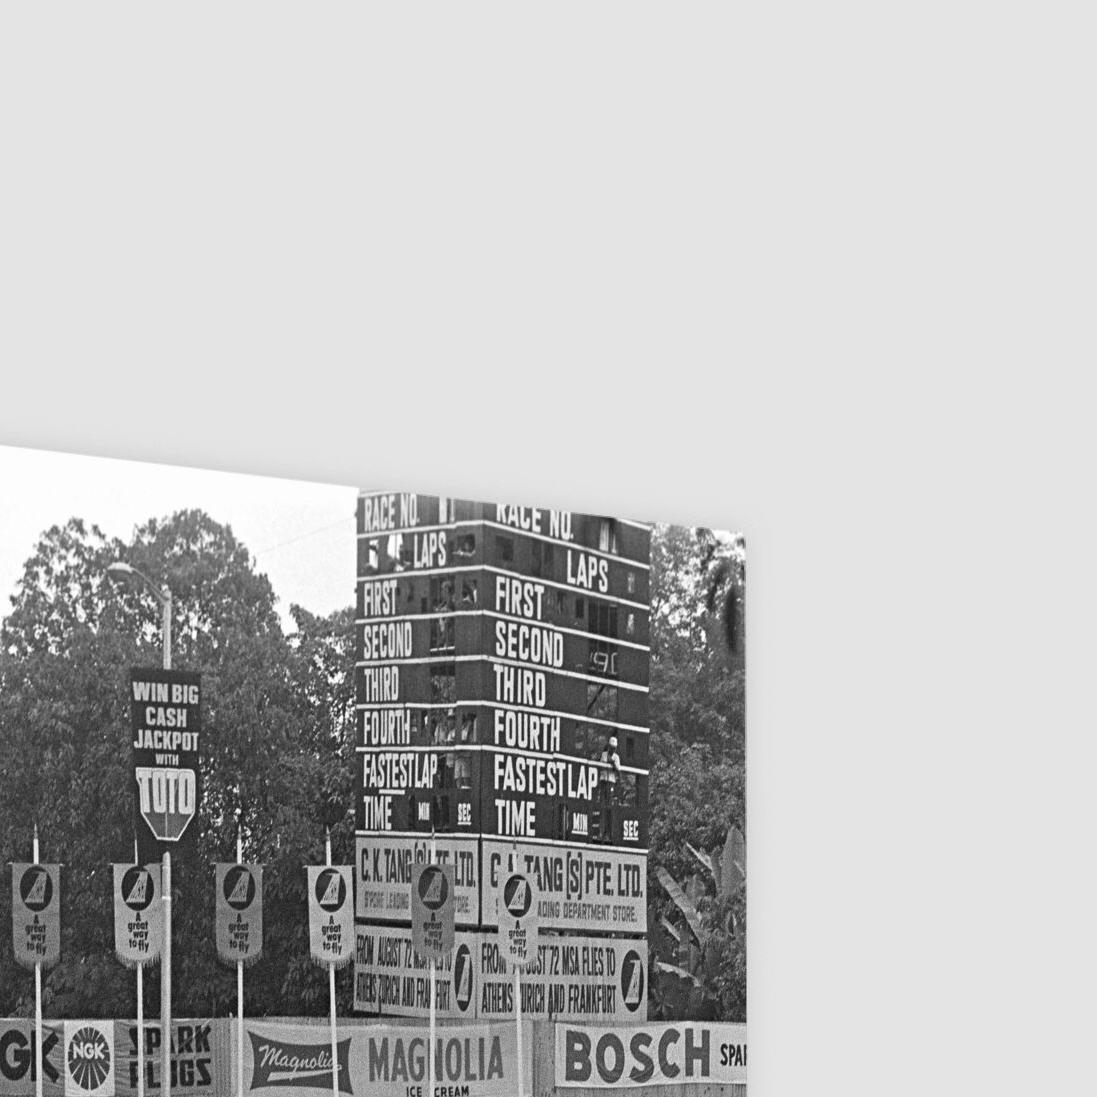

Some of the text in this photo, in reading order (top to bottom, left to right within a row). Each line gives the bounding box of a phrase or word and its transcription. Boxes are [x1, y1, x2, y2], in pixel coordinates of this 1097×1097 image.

[364, 495, 395, 532] RACE
[497, 503, 541, 534] RACE
[413, 531, 447, 568] LAPS
[567, 549, 608, 593] LAPS
[364, 579, 397, 616] FIRST
[496, 576, 544, 620] FIRST
[364, 622, 412, 659] SECOND
[495, 620, 564, 668] SECOND
[133, 681, 199, 704] WIN BIG
[364, 666, 399, 702] THIRD
[494, 664, 546, 708] THIRD
[146, 706, 187, 727] CASH
[364, 710, 411, 745] FOURTH
[495, 709, 560, 751] FOURTH
[134, 729, 199, 751] JACKPOT
[155, 754, 179, 766] WITH
[136, 768, 195, 814] TOTO
[363, 796, 392, 830] TIME
[458, 803, 471, 822] SEC
[495, 799, 639, 838] TIME MIN SEC
[384, 848, 412, 884] TANG
[524, 854, 563, 892] TANG
[586, 860, 614, 897] PTE.
[617, 863, 643, 898] LTD.
[128, 921, 148, 933] great
[563, 902, 610, 921] DEPARTMENT
[133, 931, 148, 941] way
[228, 923, 249, 934] great
[234, 932, 249, 942] way
[322, 924, 341, 936] great
[326, 933, 341, 944] way
[508, 929, 526, 940] great
[129, 939, 149, 953] to fly
[229, 940, 249, 954] to fly
[323, 941, 342, 956] to fly
[509, 946, 527, 961] to fly
[513, 939, 526, 950] way
[562, 945, 579, 976] MSA
[582, 946, 603, 976] FLIES
[606, 947, 615, 976] TO
[482, 982, 616, 1013] ATHENS URICH AND FRANKFURT
[73, 1042, 105, 1060] NGK
[258, 1044, 341, 1081] Magnolia
[368, 1036, 504, 1082] MAGNOLIA
[565, 1028, 711, 1084] BOSCH
[406, 1085, 469, 1097] ICE CREAM
